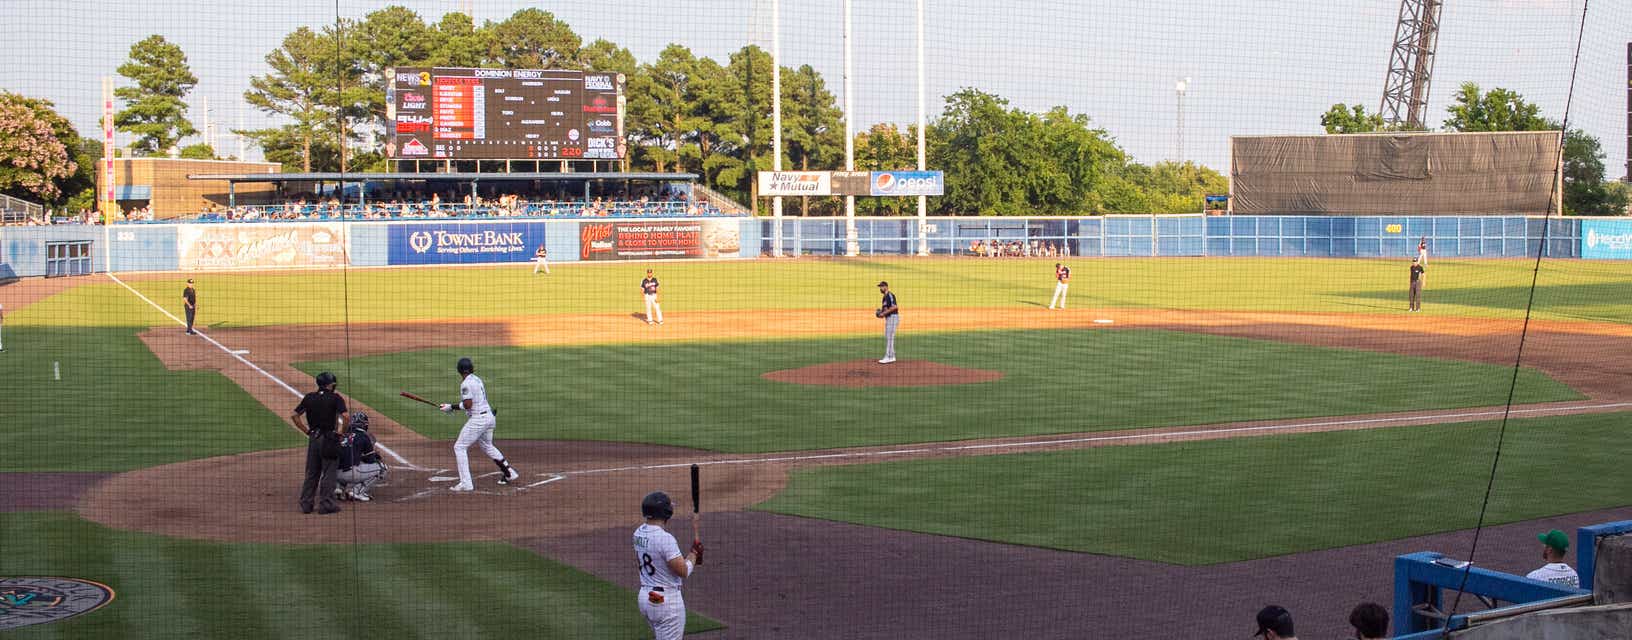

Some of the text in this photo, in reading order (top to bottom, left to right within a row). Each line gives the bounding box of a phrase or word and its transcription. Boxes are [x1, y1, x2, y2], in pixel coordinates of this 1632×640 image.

[396, 73, 420, 83] NEWS
[419, 71, 430, 86] 3
[475, 70, 542, 78] DOMINION ENERGY
[587, 138, 615, 148] DICK'S
[561, 147, 582, 157] 220
[772, 172, 800, 183] Navy
[898, 175, 937, 190] pepsi
[780, 182, 819, 192] Mutual
[1385, 224, 1402, 233] 400
[618, 232, 649, 240] BEHIND
